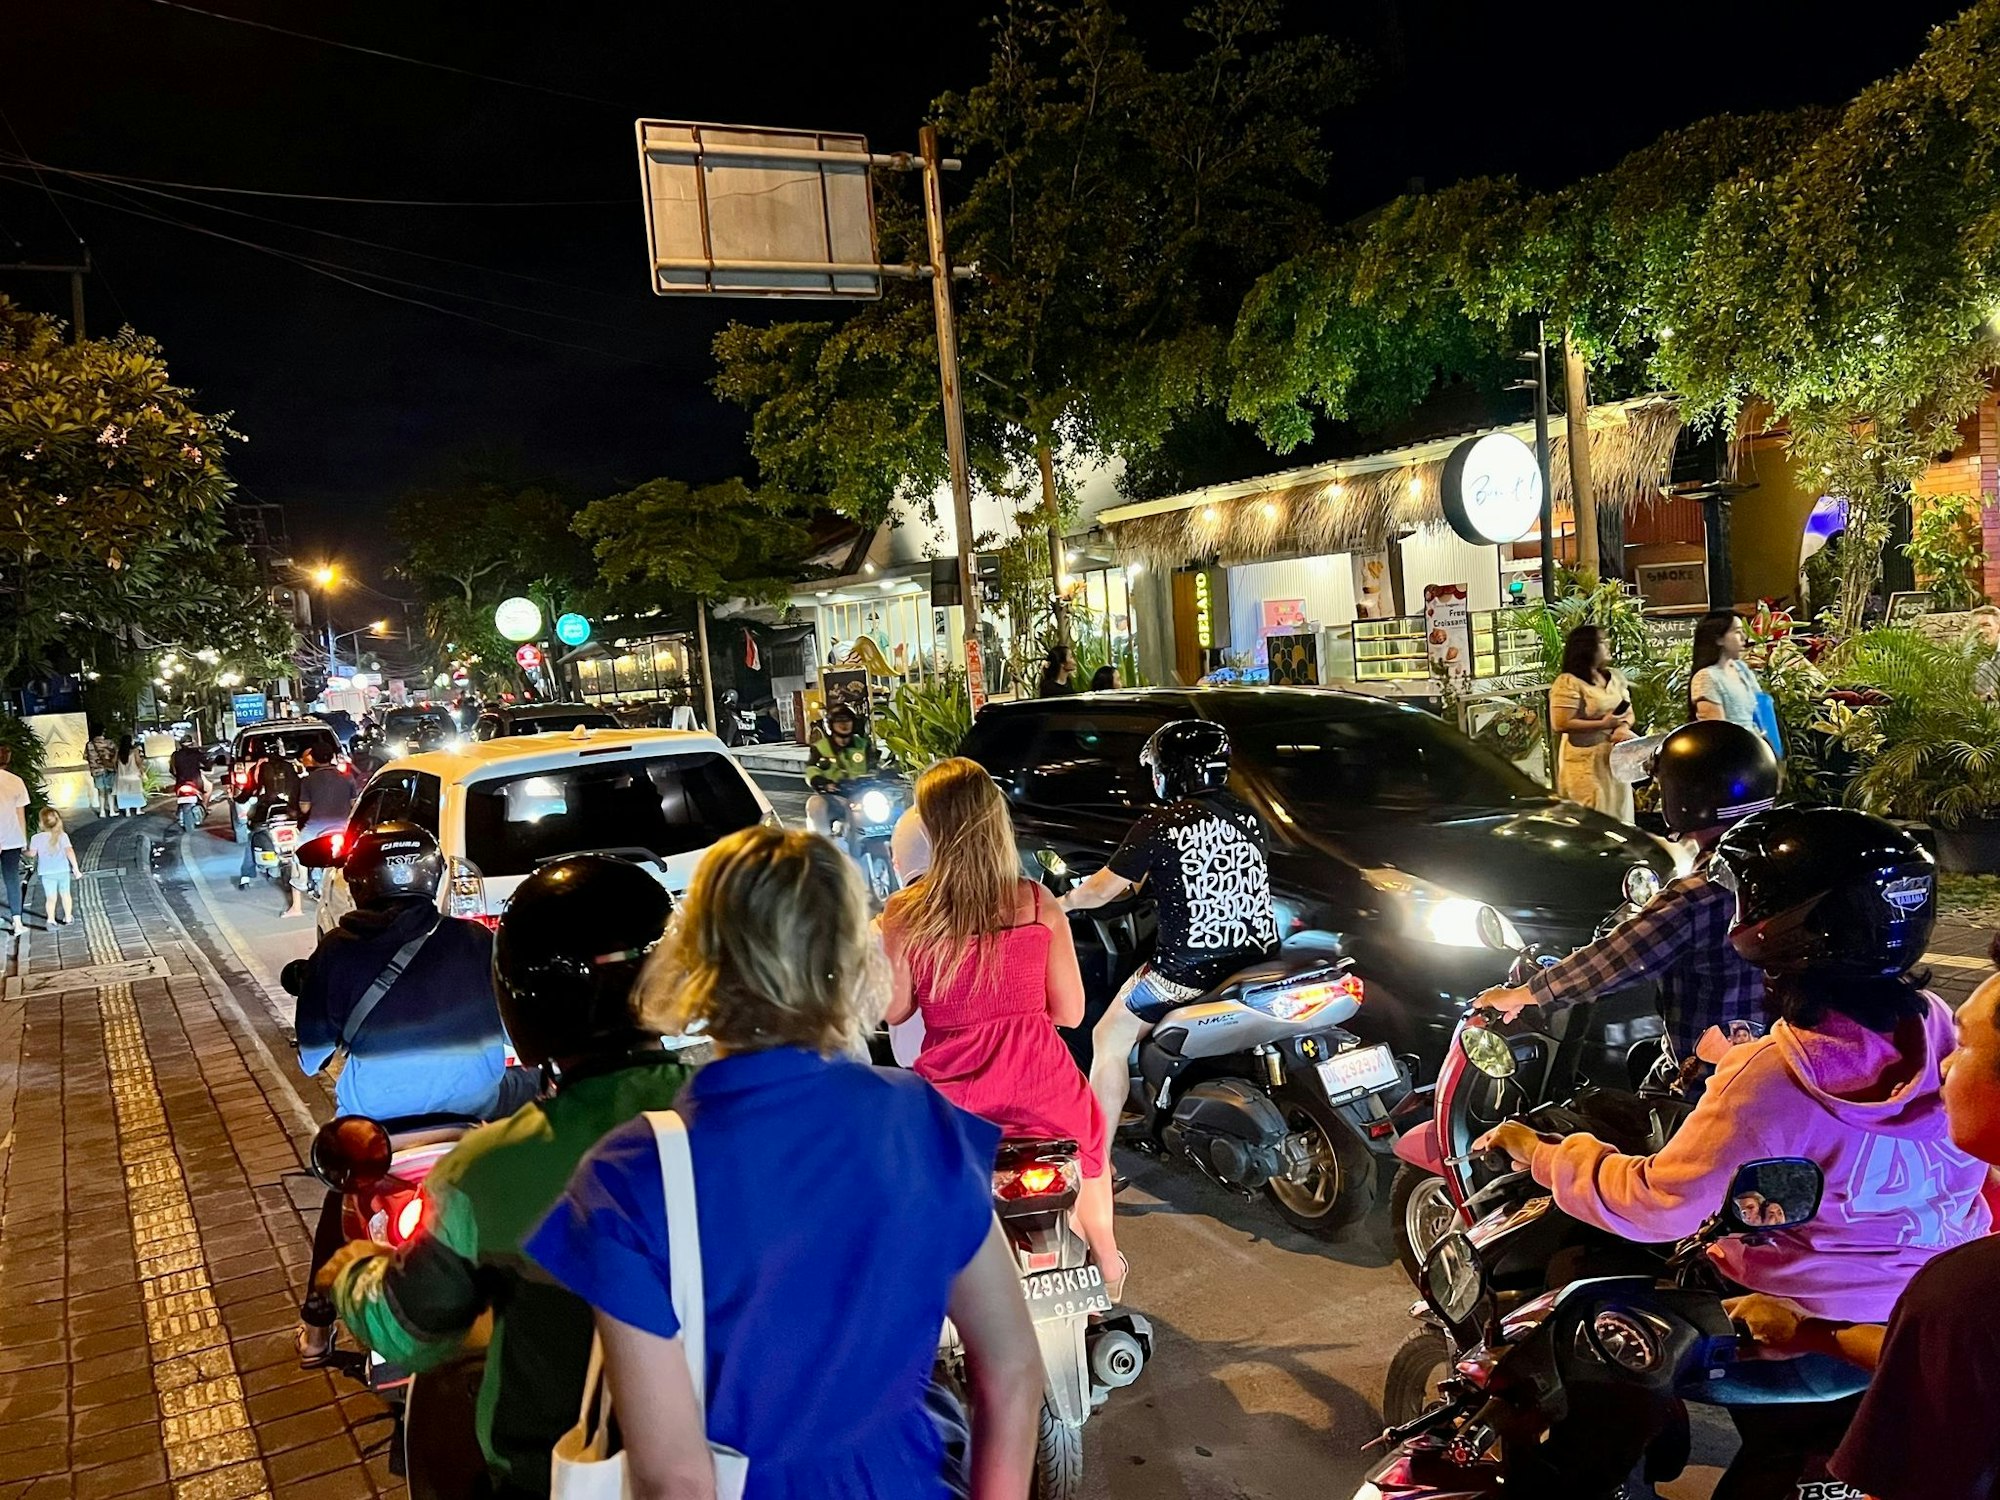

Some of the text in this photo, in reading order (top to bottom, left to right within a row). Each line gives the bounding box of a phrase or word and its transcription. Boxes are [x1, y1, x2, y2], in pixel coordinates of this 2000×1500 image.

[1647, 570, 1694, 582] SMOKE
[1195, 572, 1210, 647] GELATO
[1449, 609, 1466, 617] Free
[1433, 618, 1467, 628] Croissant
[236, 709, 264, 717] HOTEL
[385, 853, 421, 867] KYT
[1180, 842, 1265, 876] SYSTEM
[1895, 893, 1924, 905] YAMAHA
